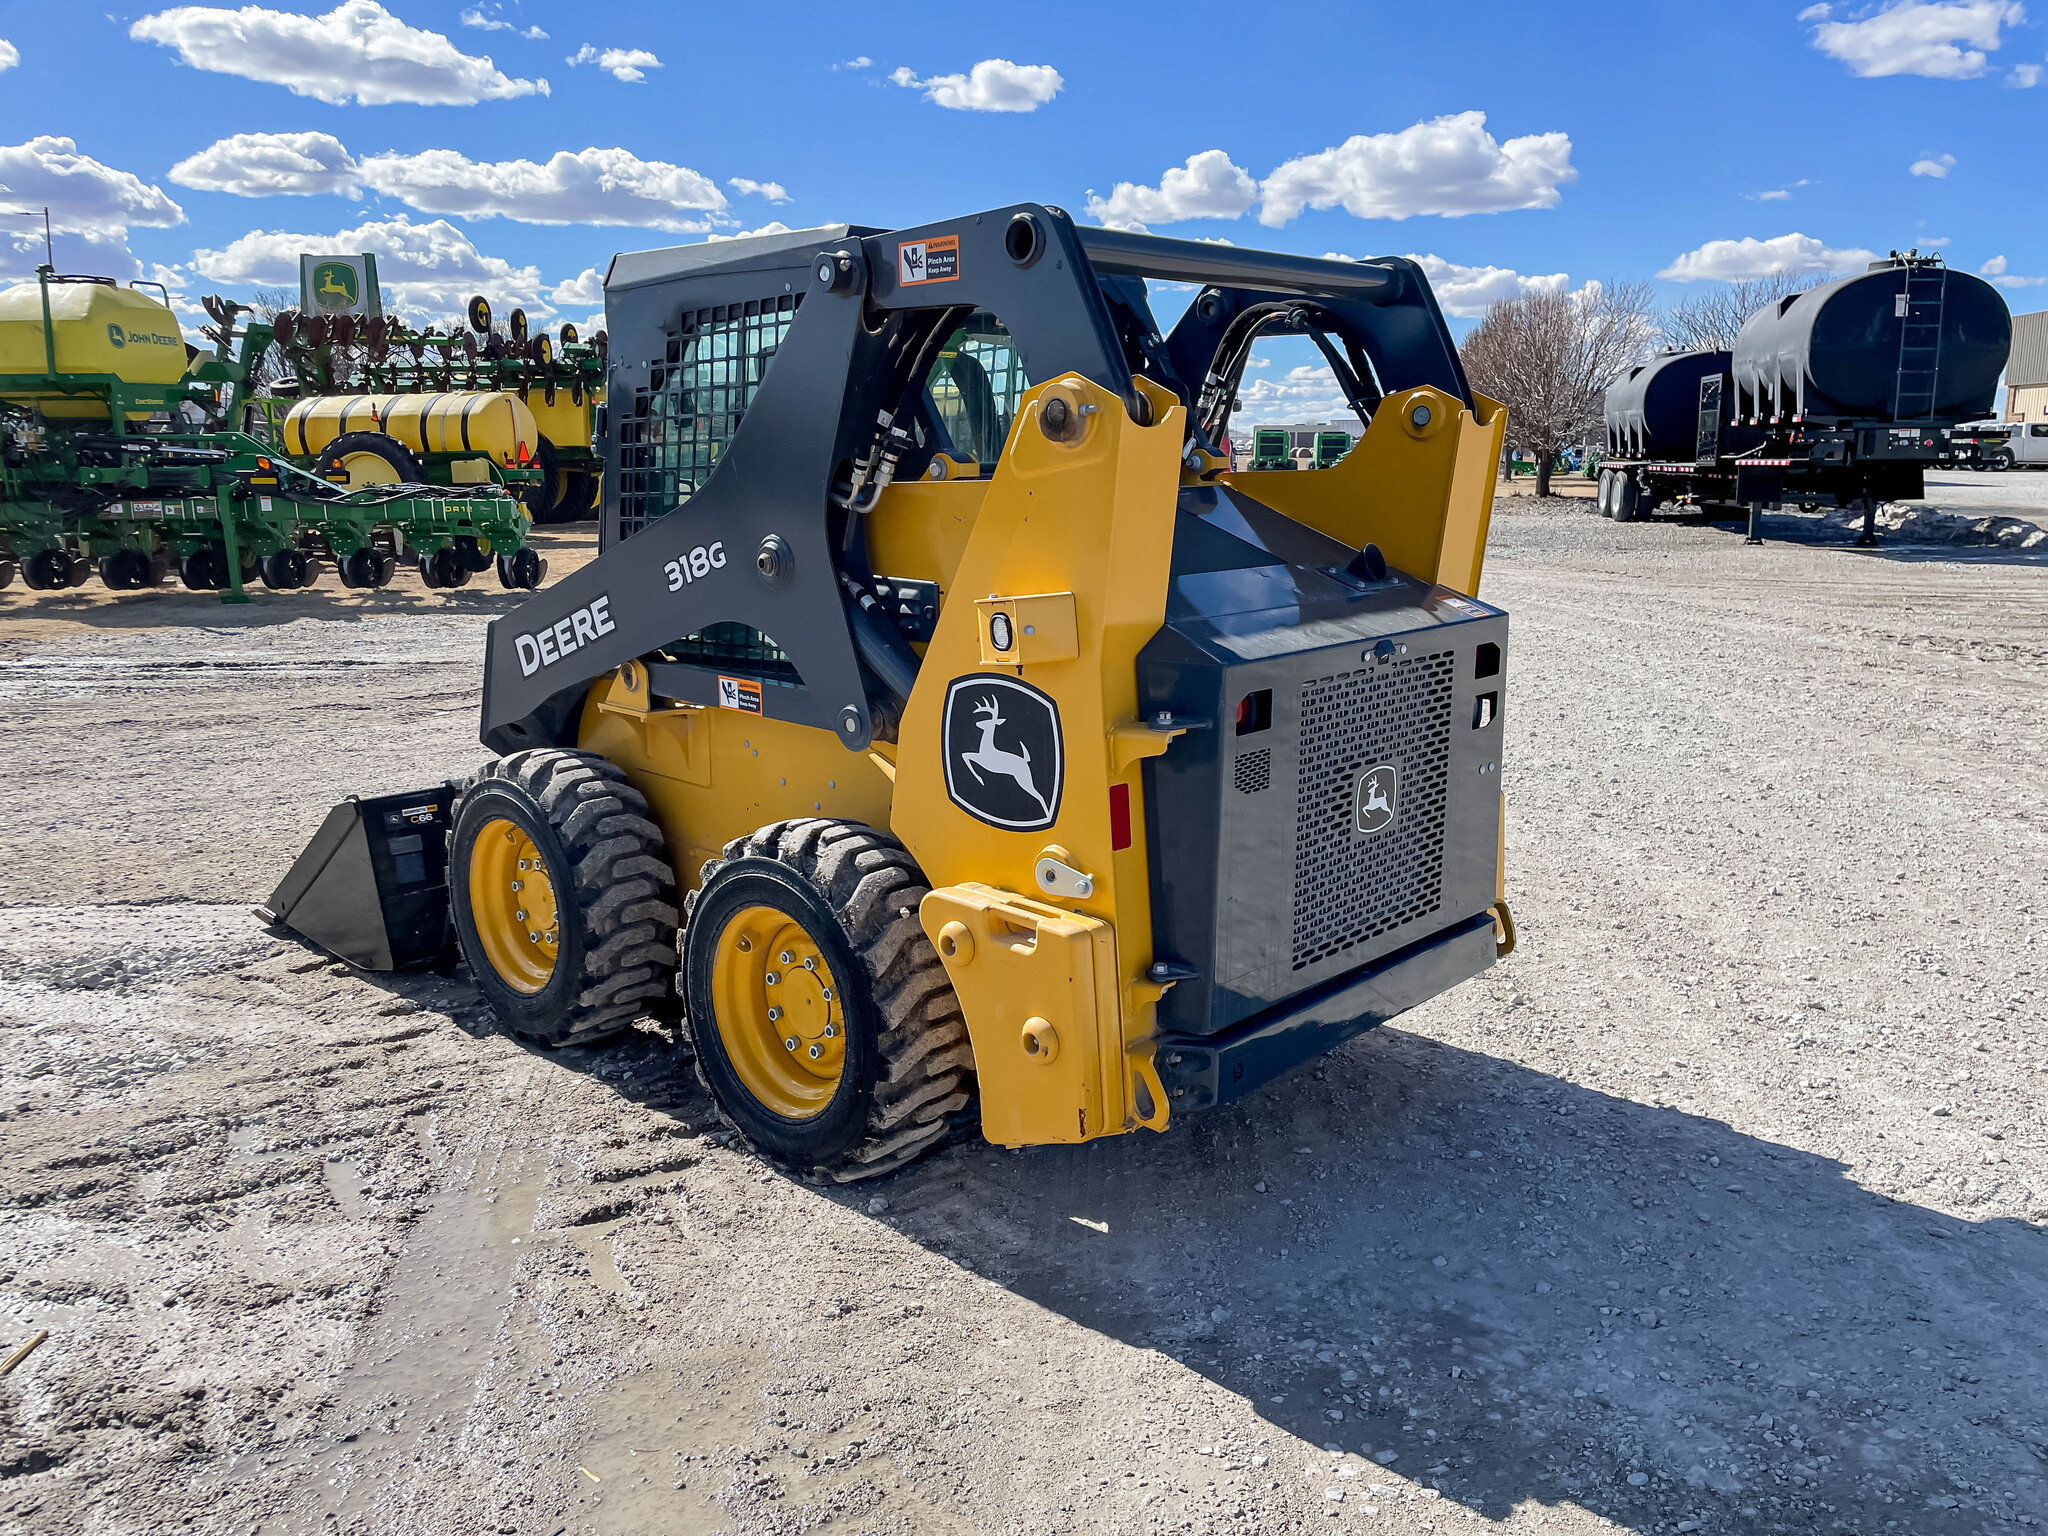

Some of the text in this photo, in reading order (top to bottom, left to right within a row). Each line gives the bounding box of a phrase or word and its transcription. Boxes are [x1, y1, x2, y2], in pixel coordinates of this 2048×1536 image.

[932, 240, 956, 248] WARNING
[928, 257, 942, 265] Pinch
[128, 331, 178, 346] JOHN DEERE
[664, 541, 727, 592] 318G
[514, 595, 615, 677] DEERE
[410, 813, 433, 823] C66
